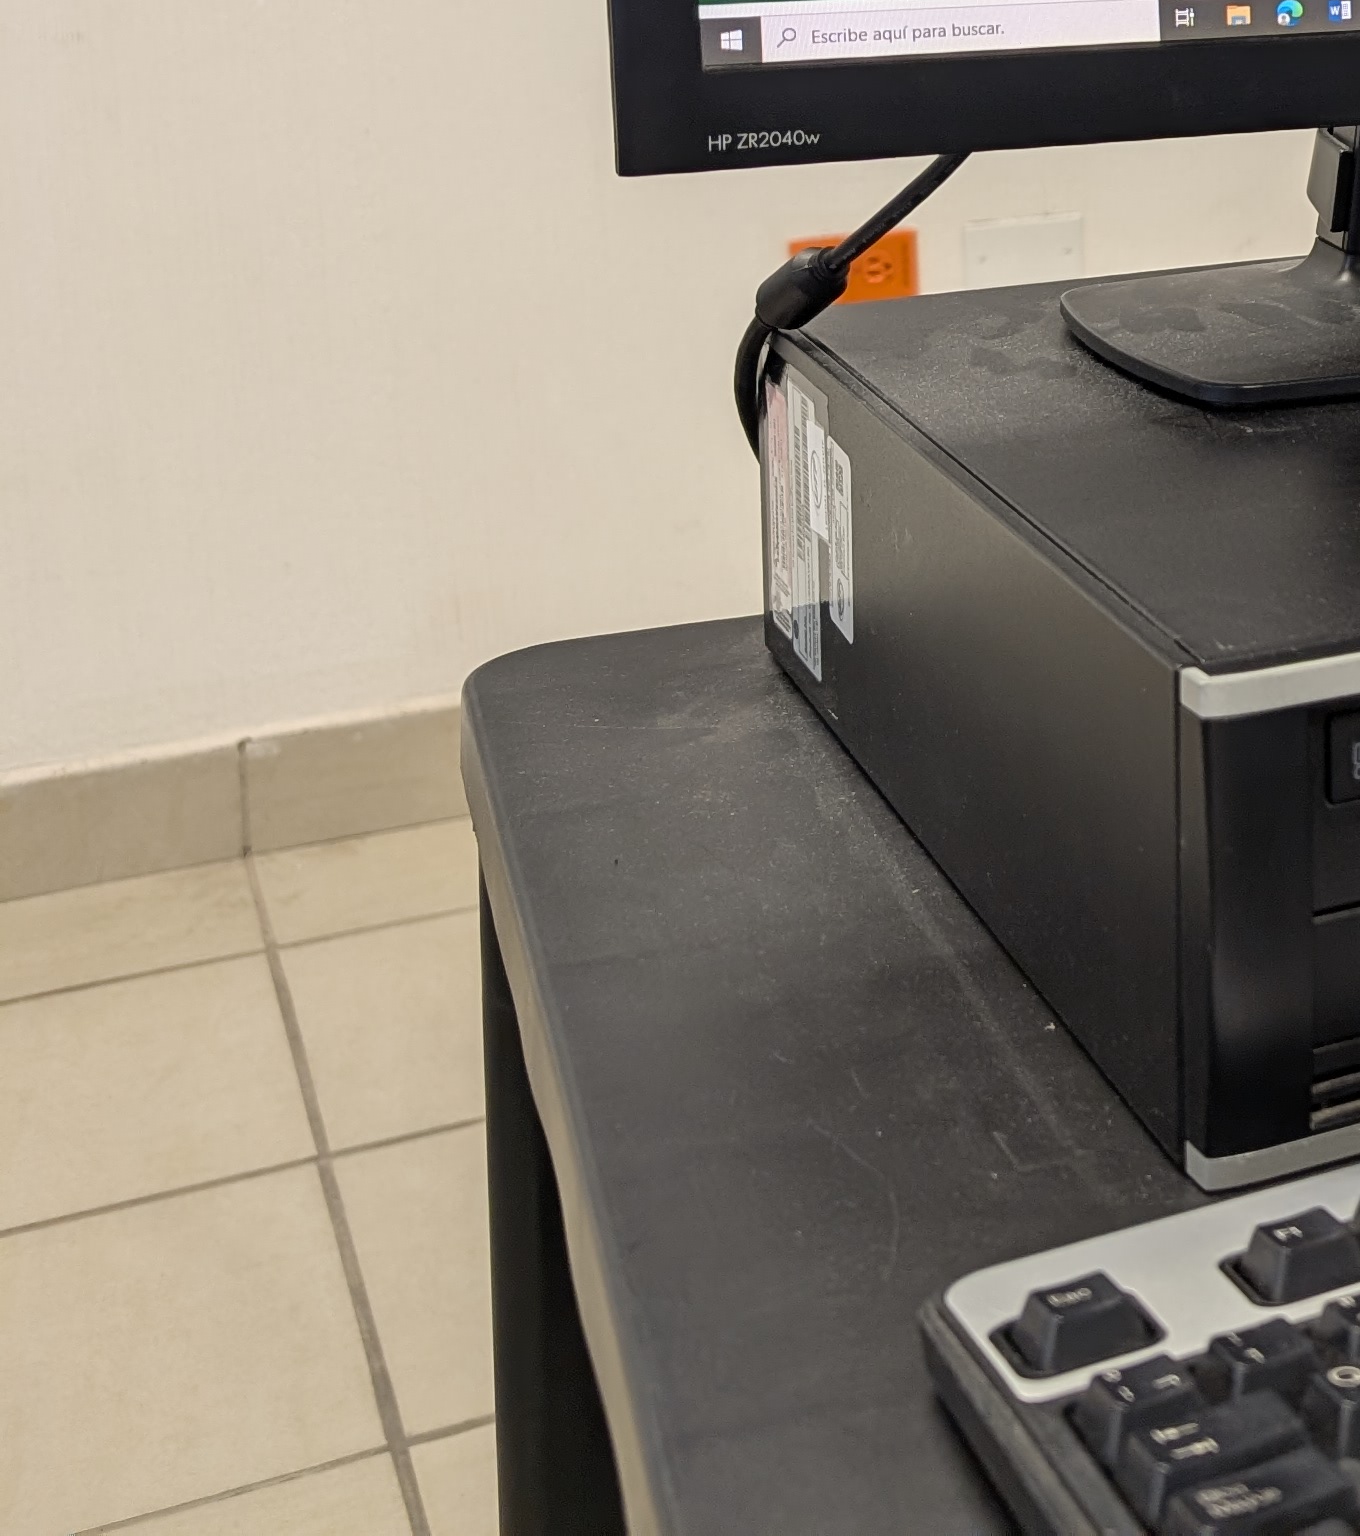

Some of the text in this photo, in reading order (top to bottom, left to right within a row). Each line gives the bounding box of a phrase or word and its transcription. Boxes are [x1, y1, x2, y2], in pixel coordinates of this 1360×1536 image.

[811, 22, 1006, 45] Escribe aquí para buscar.
[708, 129, 820, 152] HP ZR2040w
[1273, 1226, 1303, 1241] F1
